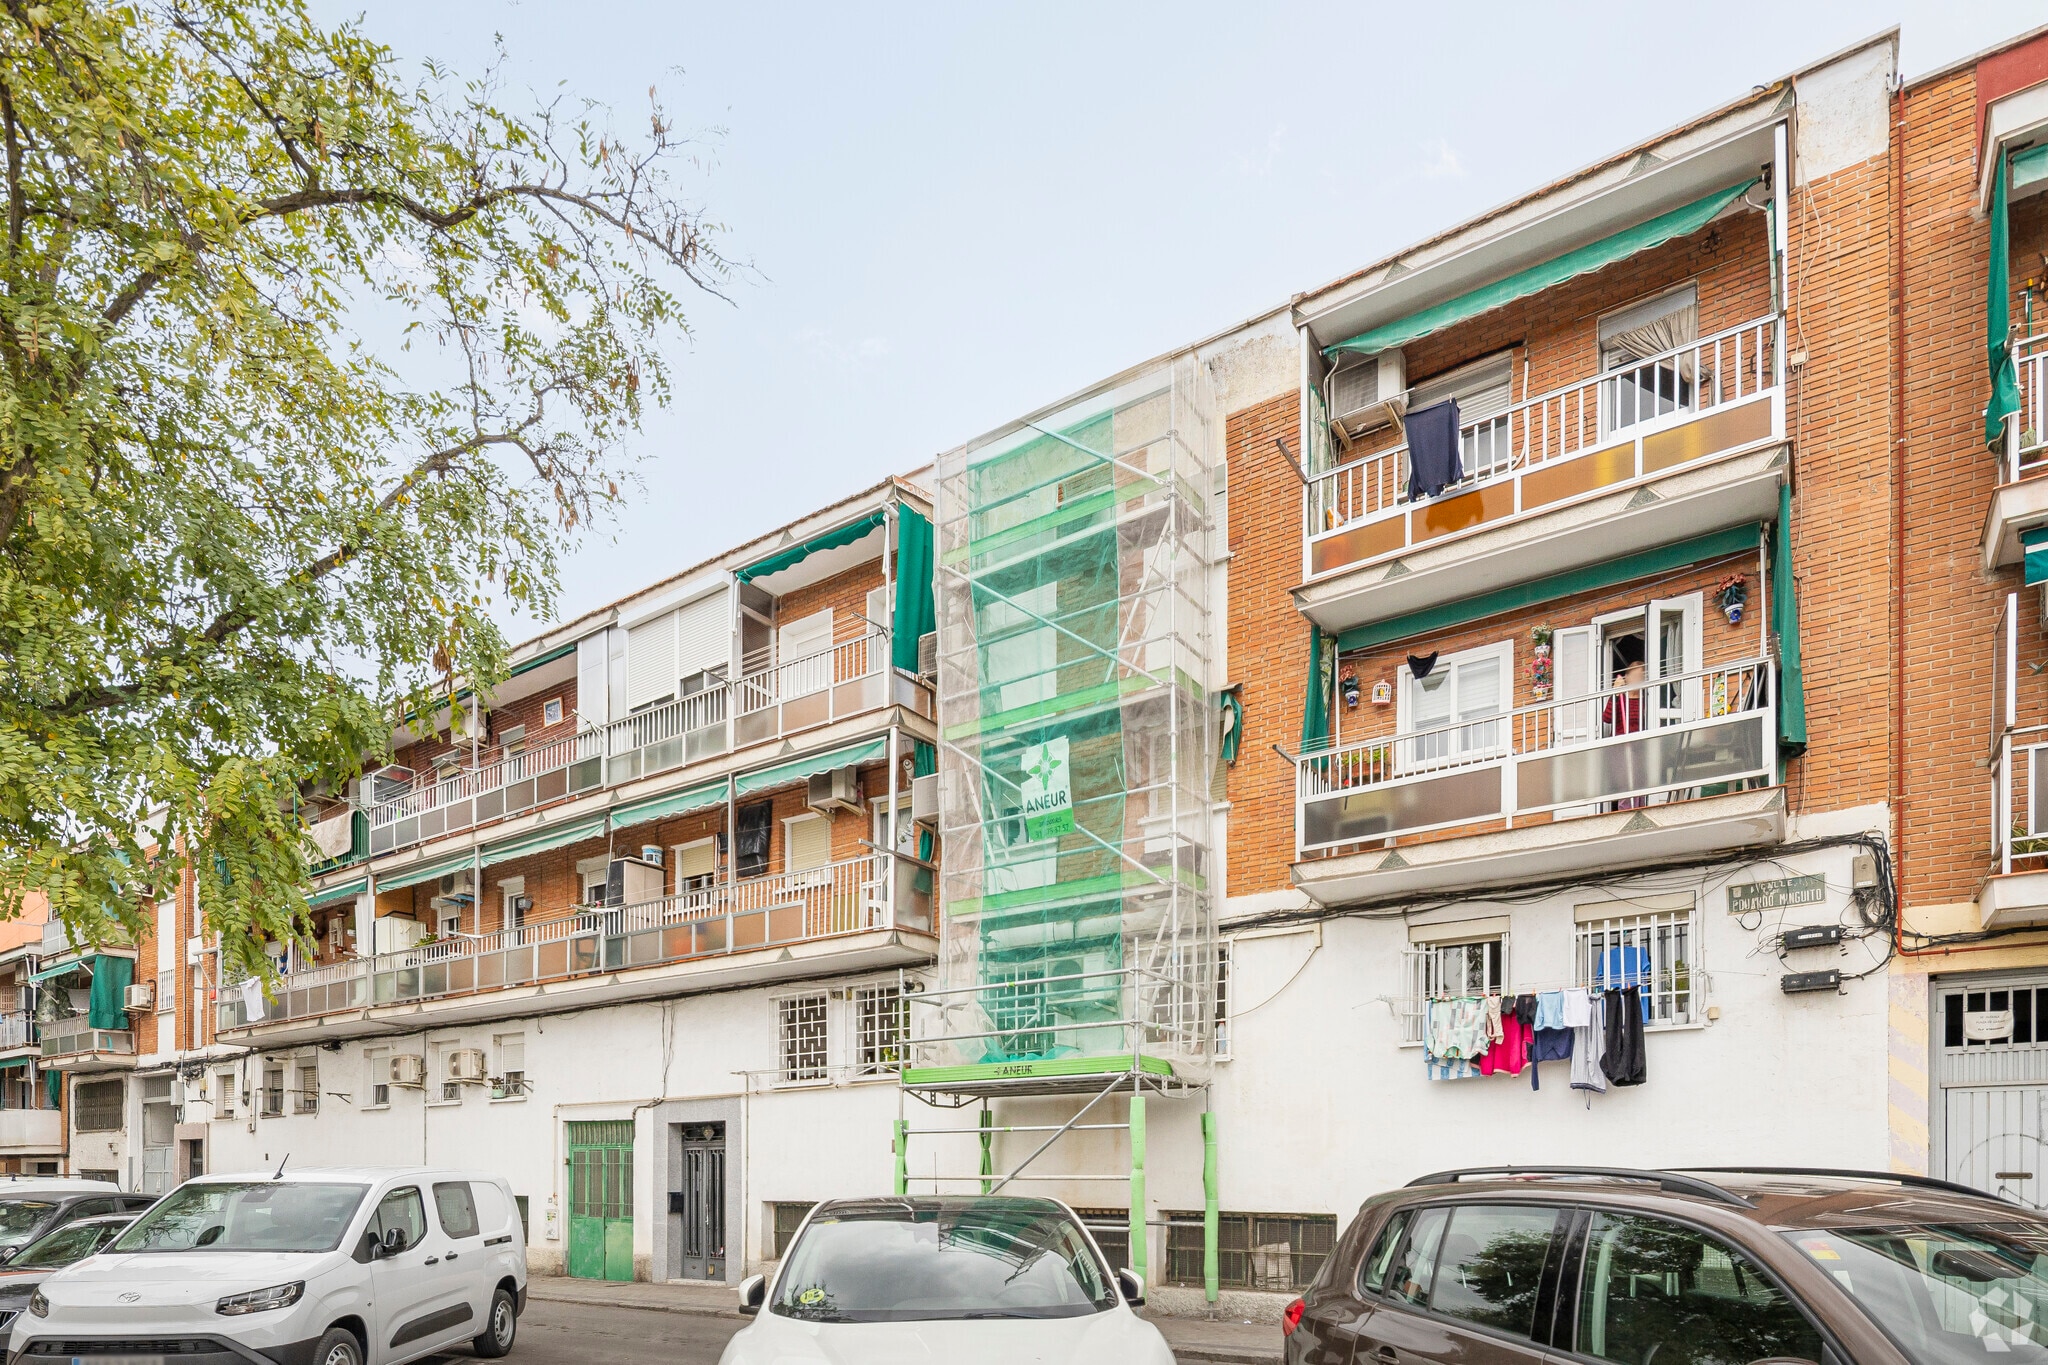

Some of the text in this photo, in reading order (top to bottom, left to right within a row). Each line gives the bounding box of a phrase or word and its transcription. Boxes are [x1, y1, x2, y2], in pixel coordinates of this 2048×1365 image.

[1026, 790, 1067, 813] ANEUR
[1732, 888, 1822, 912] EDUARDO MINGUITO
[1003, 1065, 1033, 1076] ANEUR
